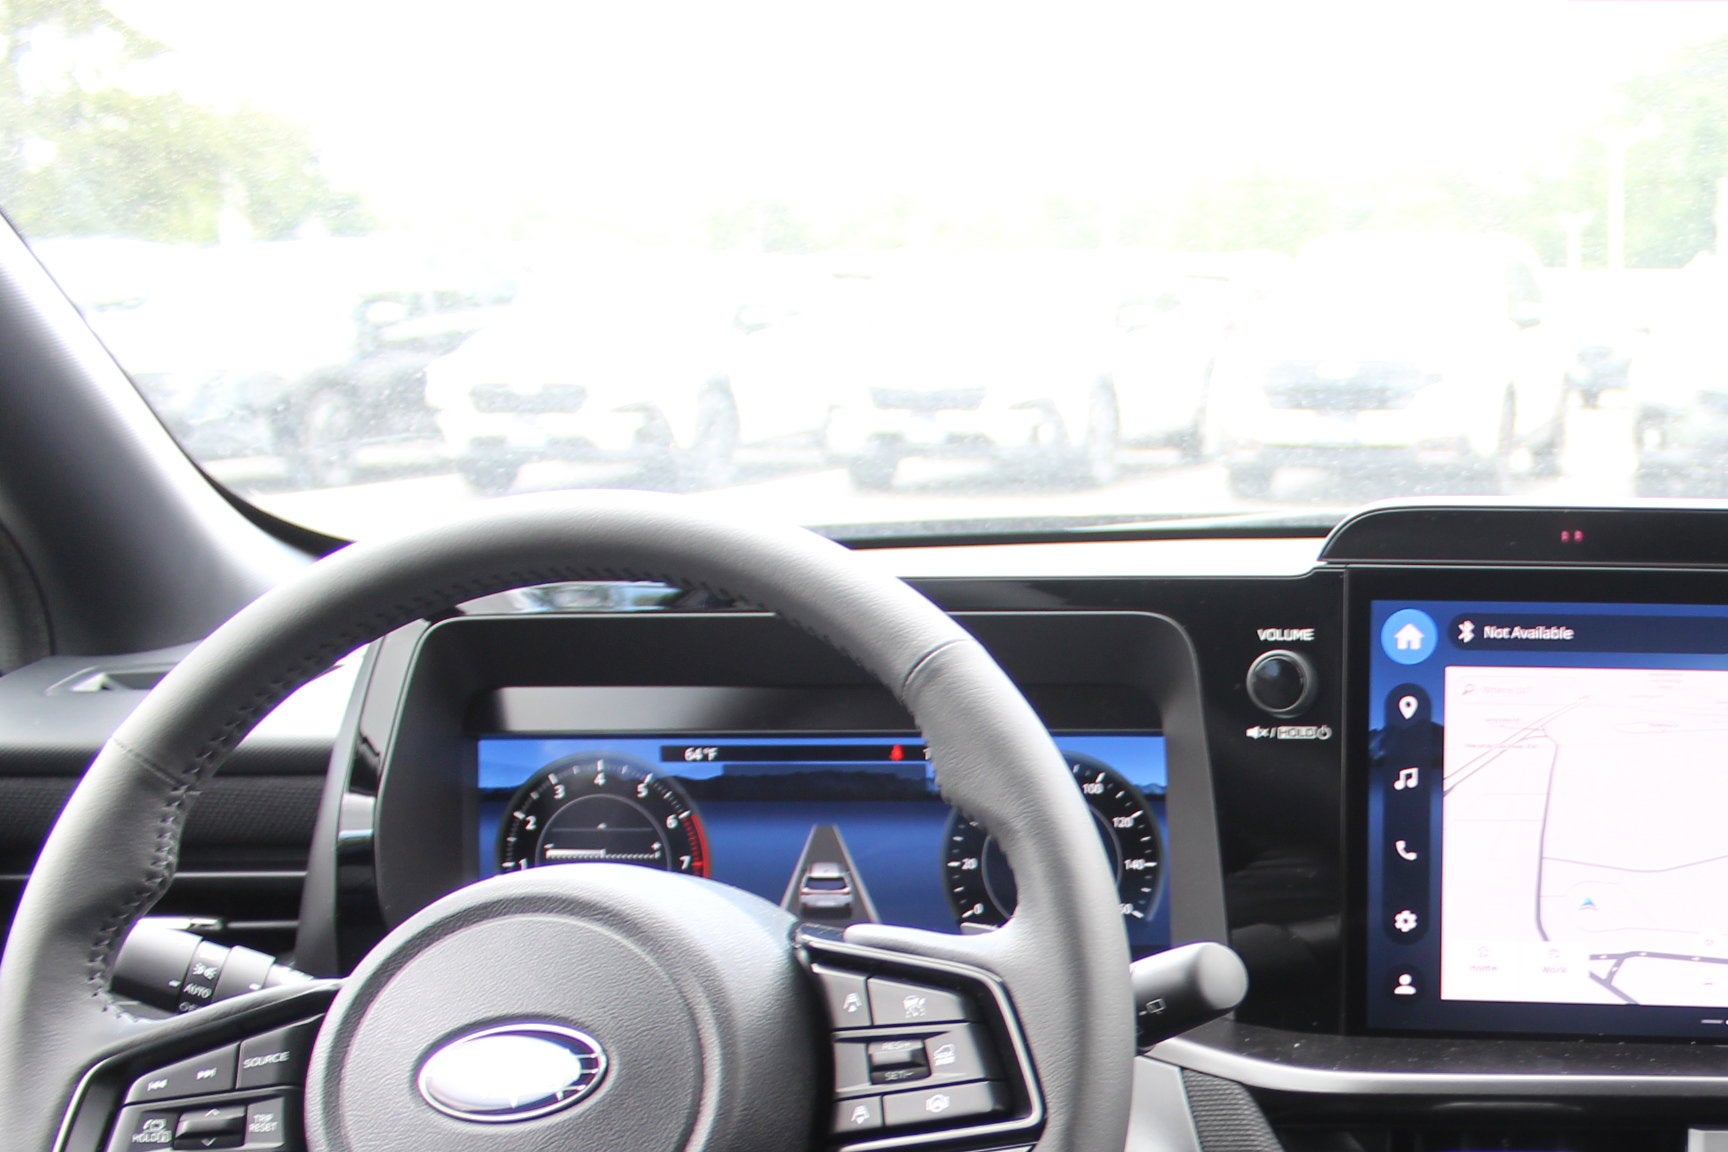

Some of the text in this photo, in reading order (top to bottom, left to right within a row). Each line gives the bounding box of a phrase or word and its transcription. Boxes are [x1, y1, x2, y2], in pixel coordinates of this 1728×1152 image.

[1257, 628, 1315, 641] VOLUME
[1483, 625, 1575, 640] Not Available
[684, 747, 719, 762] 64°F
[594, 771, 606, 786] 4
[554, 784, 566, 799] 3
[637, 784, 649, 798] 5
[1082, 783, 1105, 795] 100
[525, 815, 537, 830] 2
[666, 814, 678, 829] 6
[1113, 816, 1134, 828] 120
[518, 858, 528, 870] 1
[679, 855, 692, 870] 7
[961, 857, 979, 870] 20
[1124, 858, 1146, 870] 140
[184, 983, 213, 999] AUTO
[243, 1051, 291, 1069] SOURCE
[249, 1121, 279, 1132] RESET
